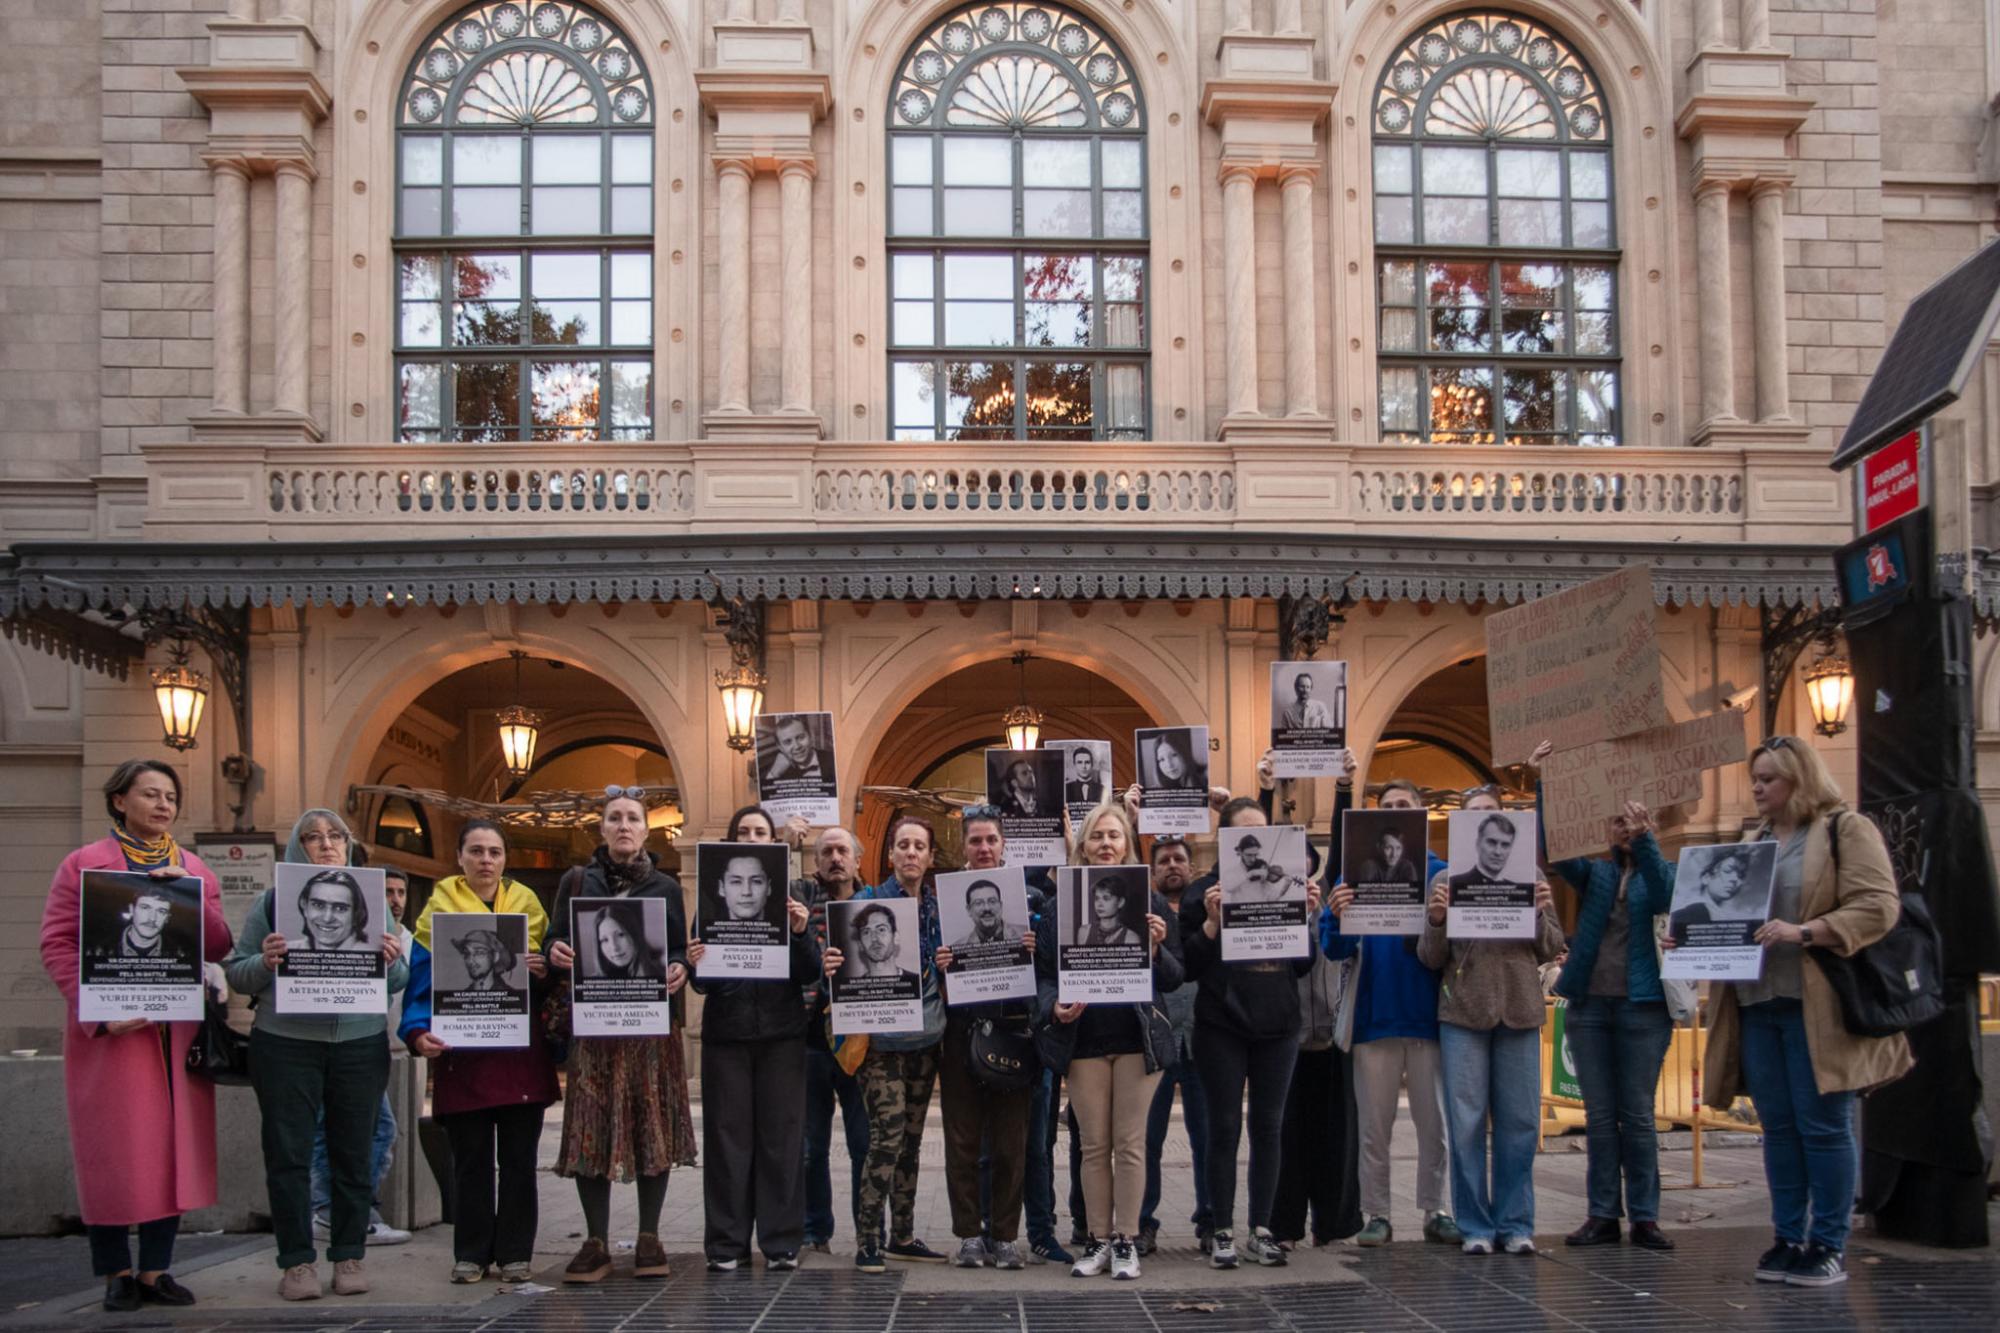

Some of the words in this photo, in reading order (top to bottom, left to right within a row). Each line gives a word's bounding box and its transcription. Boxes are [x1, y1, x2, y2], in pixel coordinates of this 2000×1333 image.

[1872, 459, 1910, 488] PARADA
[1604, 762, 1642, 787] WHY
[1653, 739, 1730, 778] RUSSIANS
[1553, 797, 1603, 826] LOVE
[1642, 774, 1701, 807] FROM
[992, 983, 1010, 991] 2022
[143, 1003, 168, 1011] 2025
[333, 996, 356, 1004] 2022
